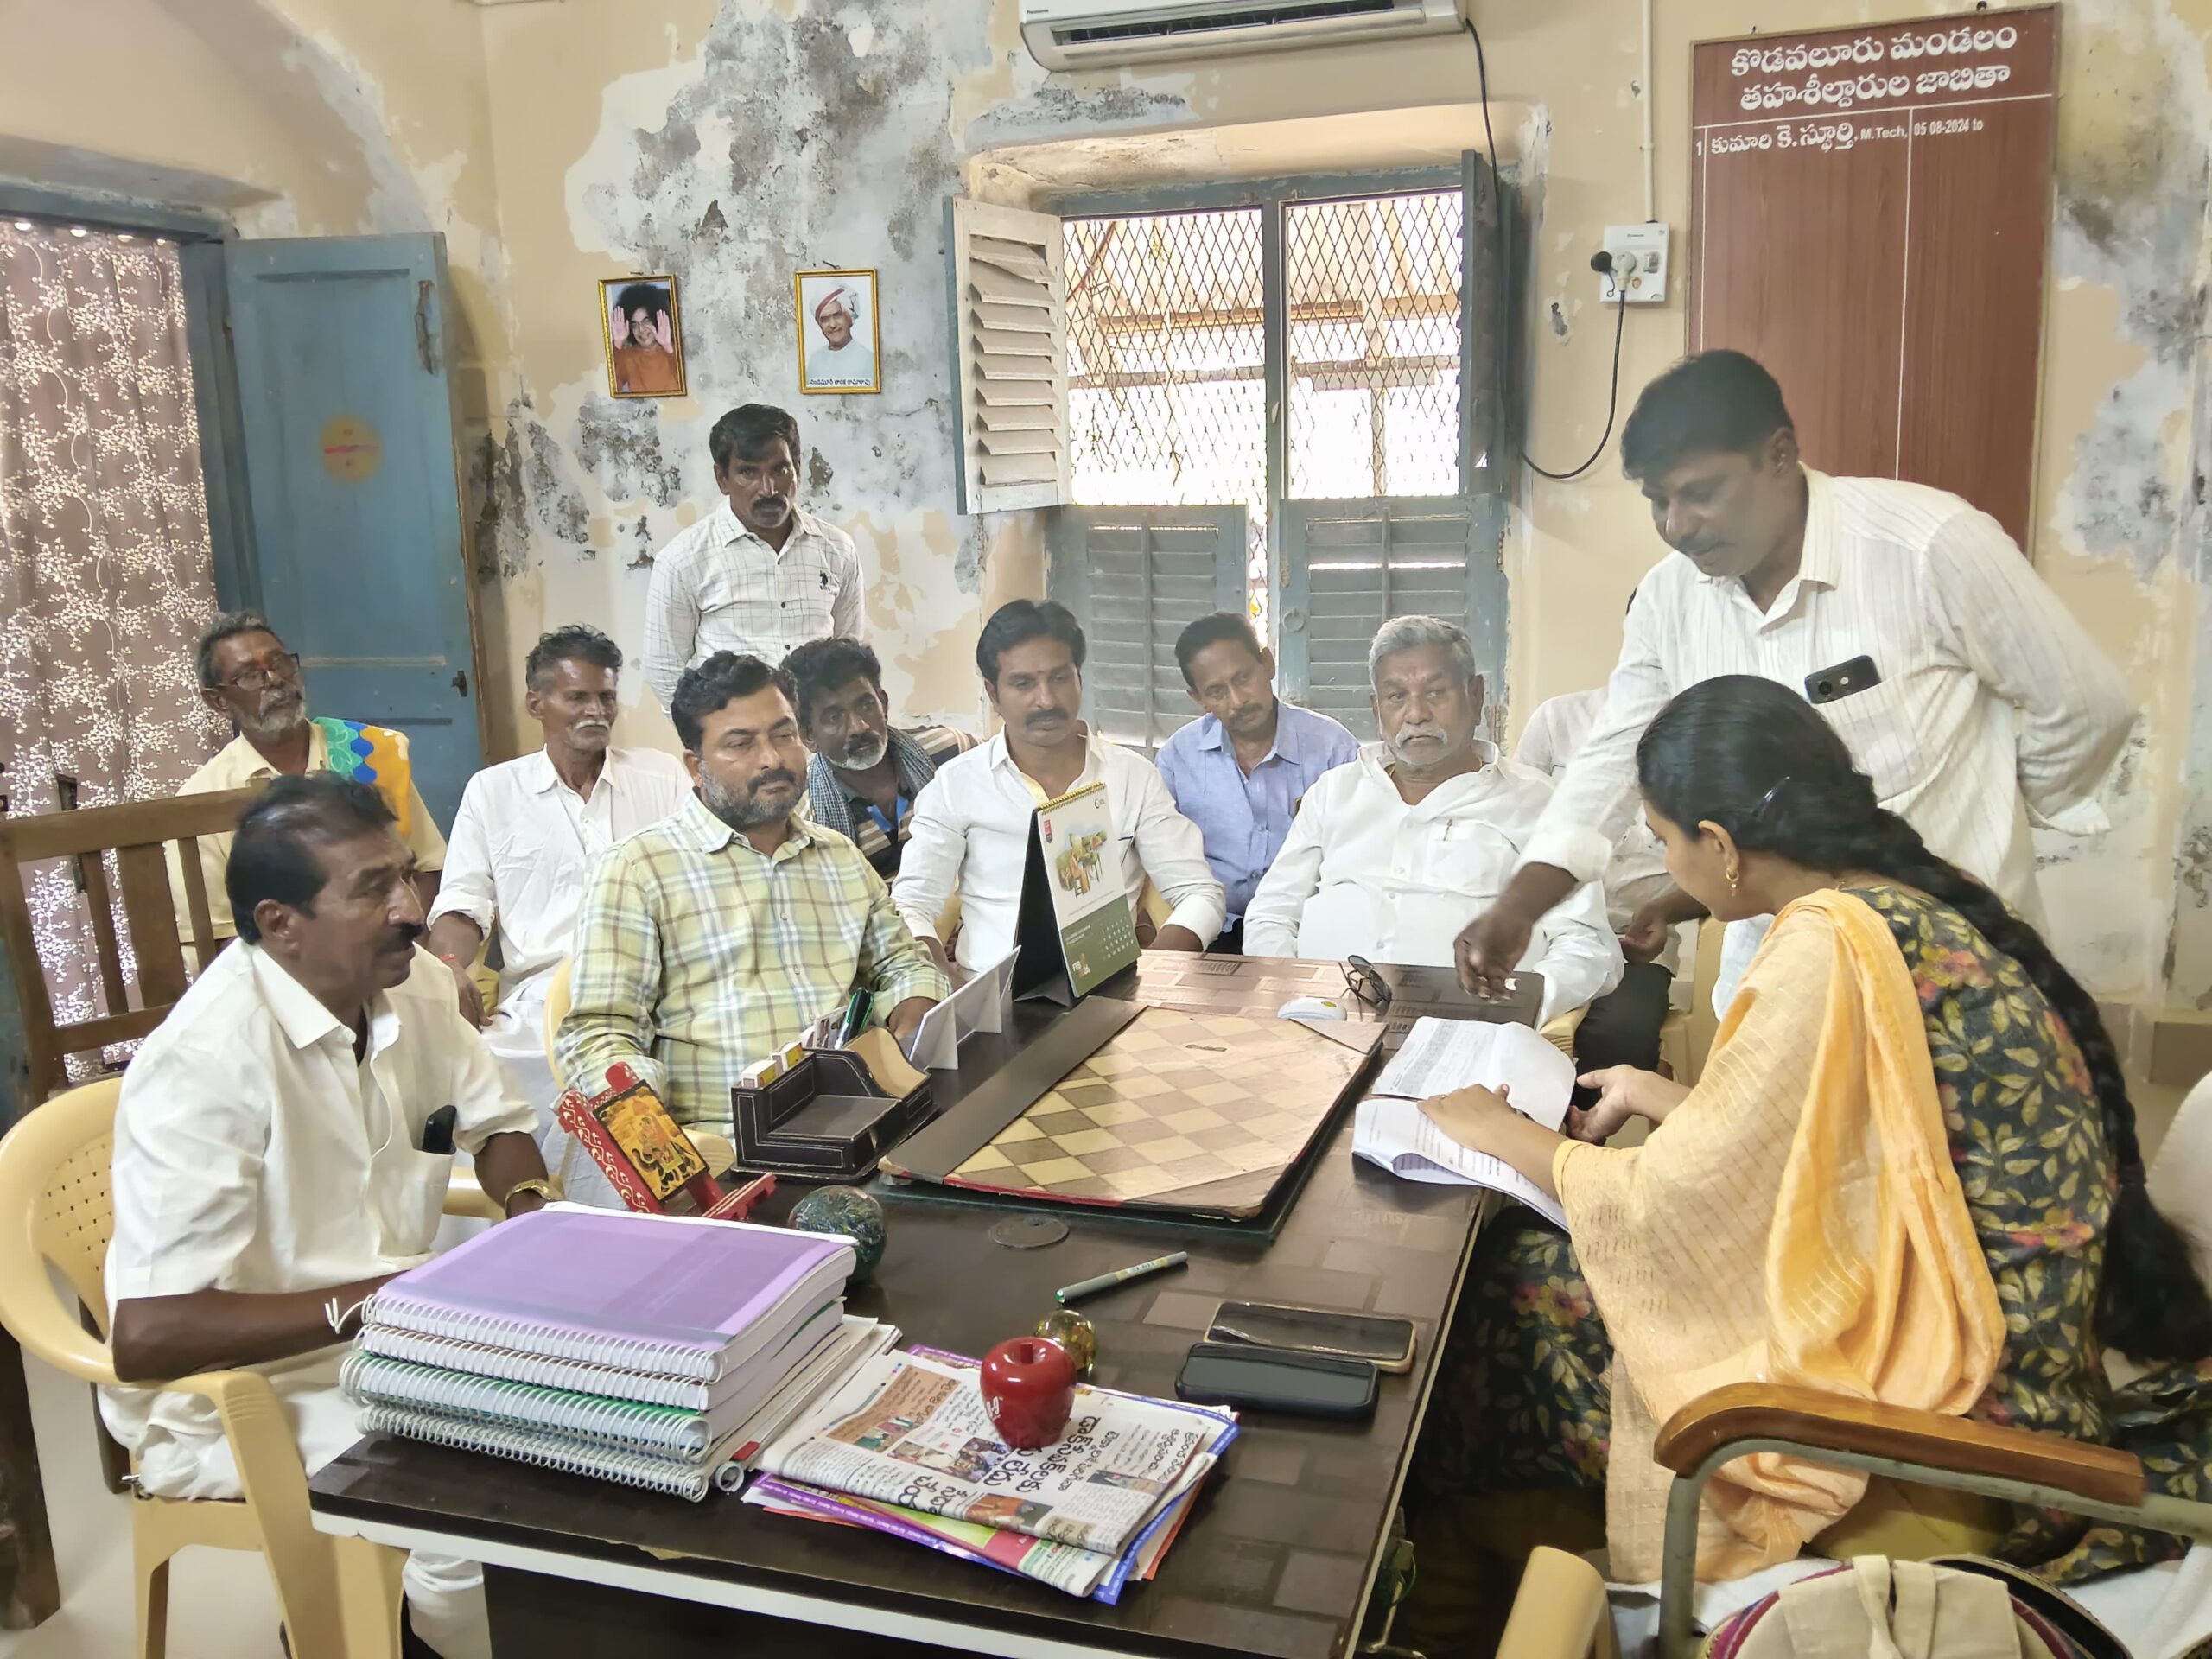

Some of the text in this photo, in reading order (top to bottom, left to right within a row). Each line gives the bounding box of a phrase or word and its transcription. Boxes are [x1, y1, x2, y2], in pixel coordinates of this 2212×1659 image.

[1731, 26, 2018, 76] కొడవలూరు మండలం
[1739, 64, 2012, 110] తహశీల్దారుల జాబితా
[1711, 134, 1773, 155] కుమారి
